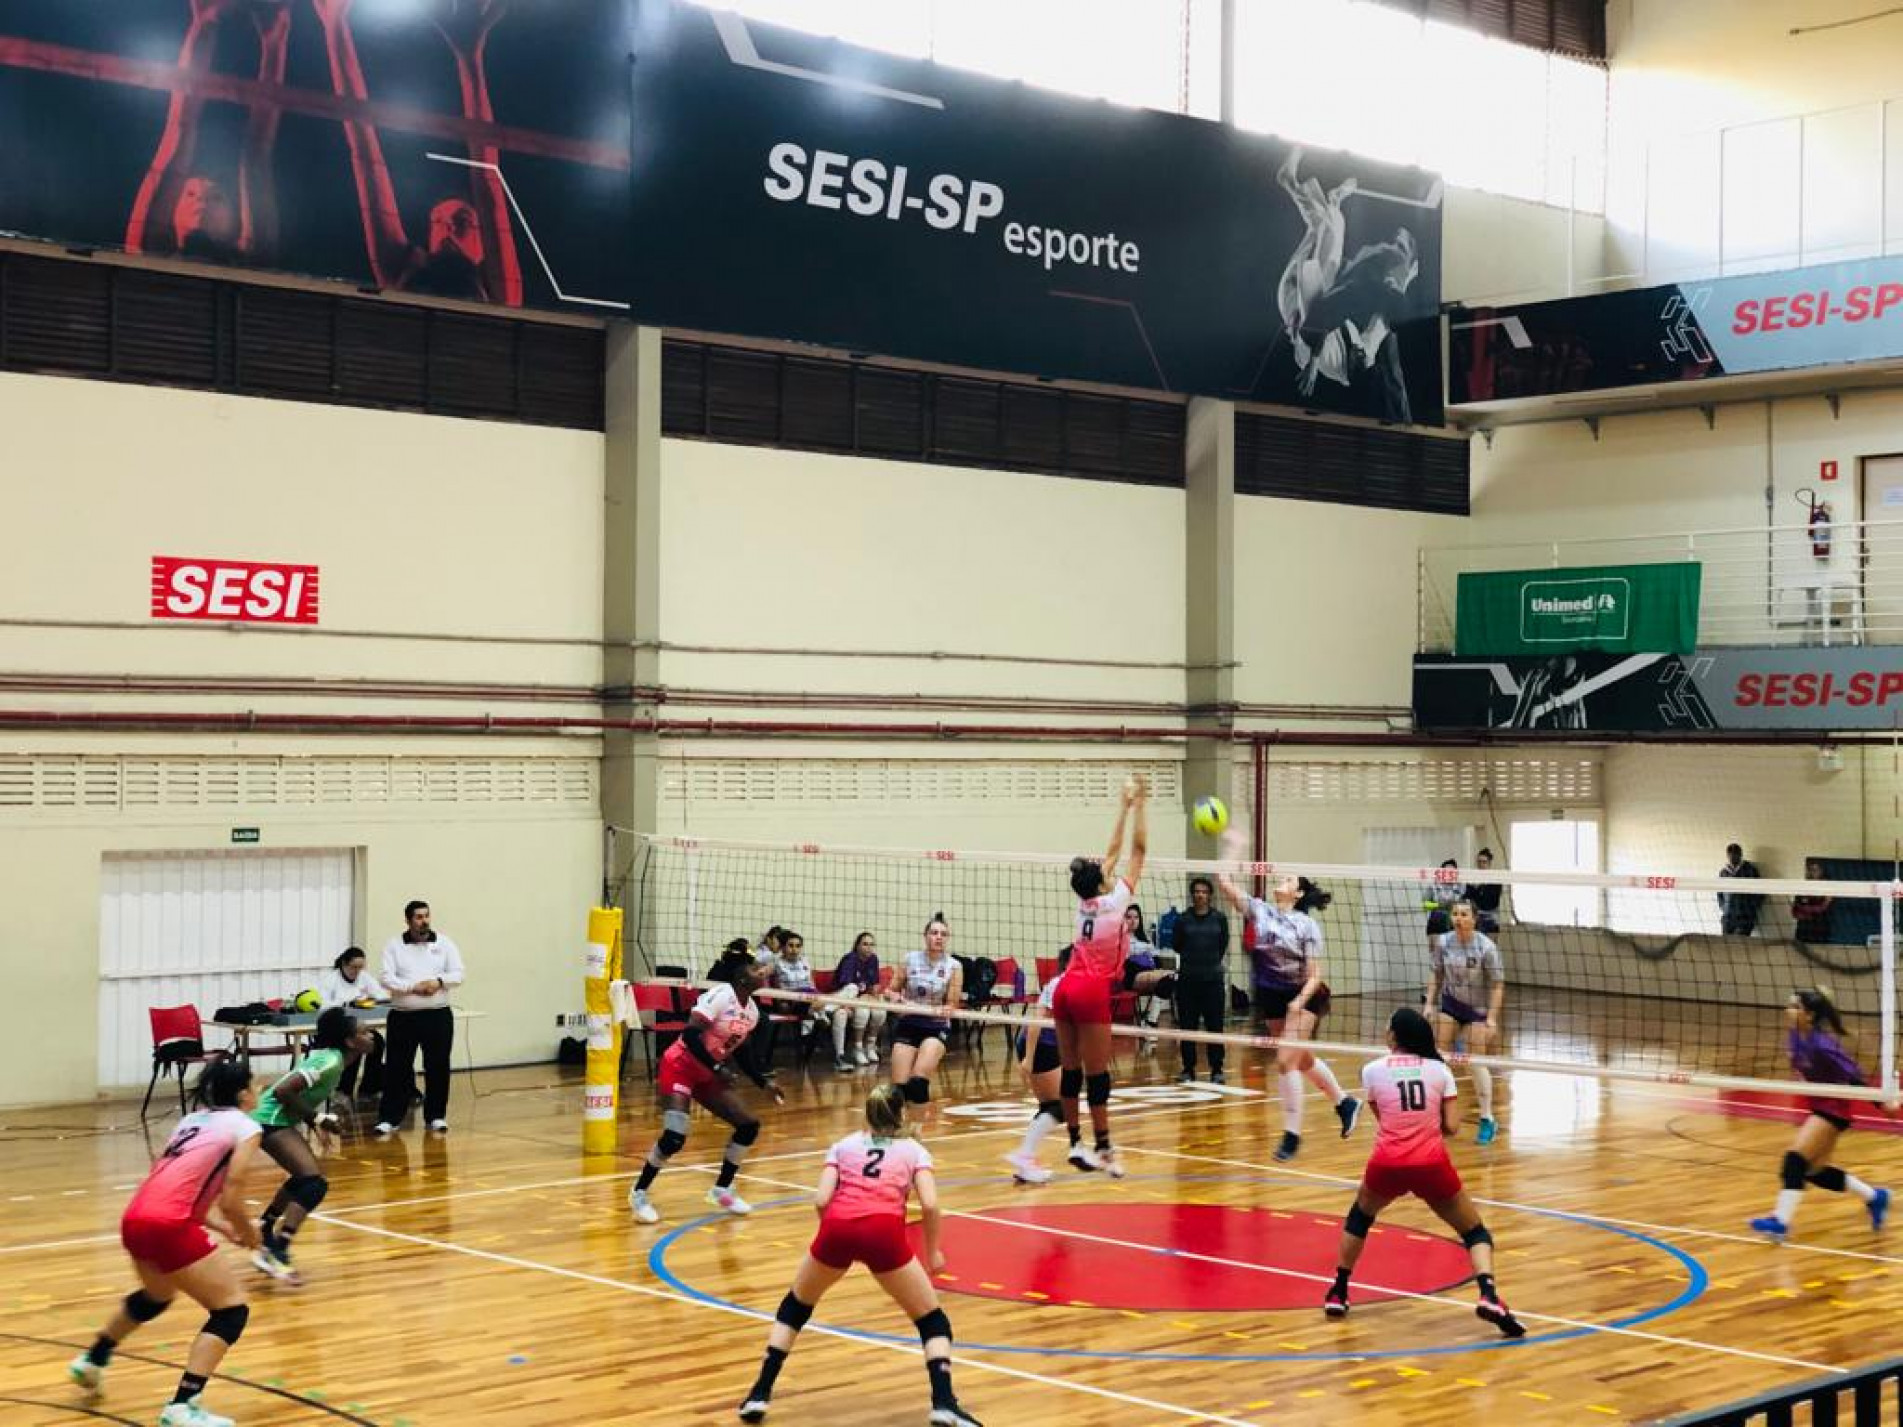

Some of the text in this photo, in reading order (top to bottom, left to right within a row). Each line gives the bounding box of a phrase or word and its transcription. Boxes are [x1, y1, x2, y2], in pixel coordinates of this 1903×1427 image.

[763, 142, 1140, 271] SESI-SP esporte
[1731, 282, 1903, 335] SESI-SP
[166, 564, 305, 618] SESI
[1531, 595, 1594, 613] Unimed
[1734, 671, 1903, 706] SESI-SP
[1647, 876, 1676, 889] SESI
[1397, 1080, 1426, 1111] 10
[862, 1148, 885, 1179] 2
